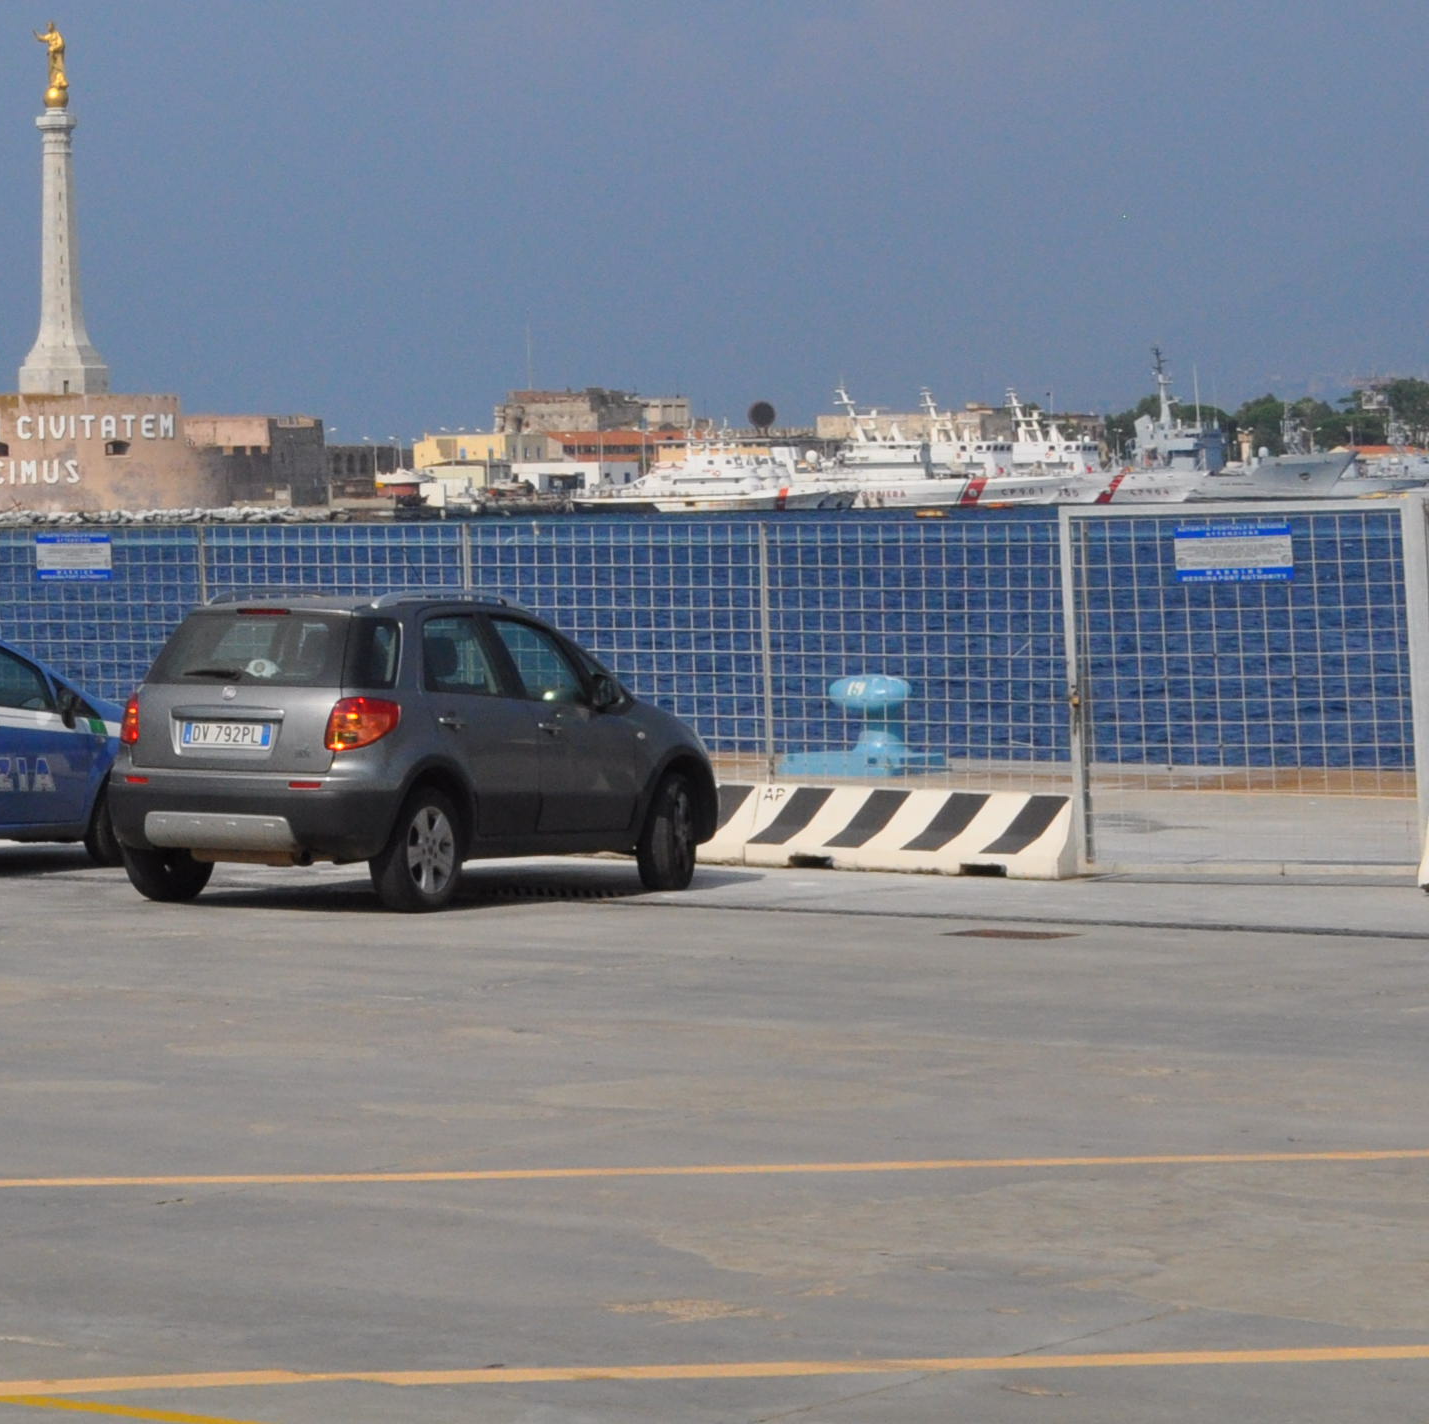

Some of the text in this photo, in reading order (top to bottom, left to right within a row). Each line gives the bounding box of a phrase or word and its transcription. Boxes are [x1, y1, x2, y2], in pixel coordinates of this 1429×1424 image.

[17, 414, 175, 440] CIVITATEM
[193, 725, 258, 744] DV 792PL
[763, 787, 786, 802] AP
